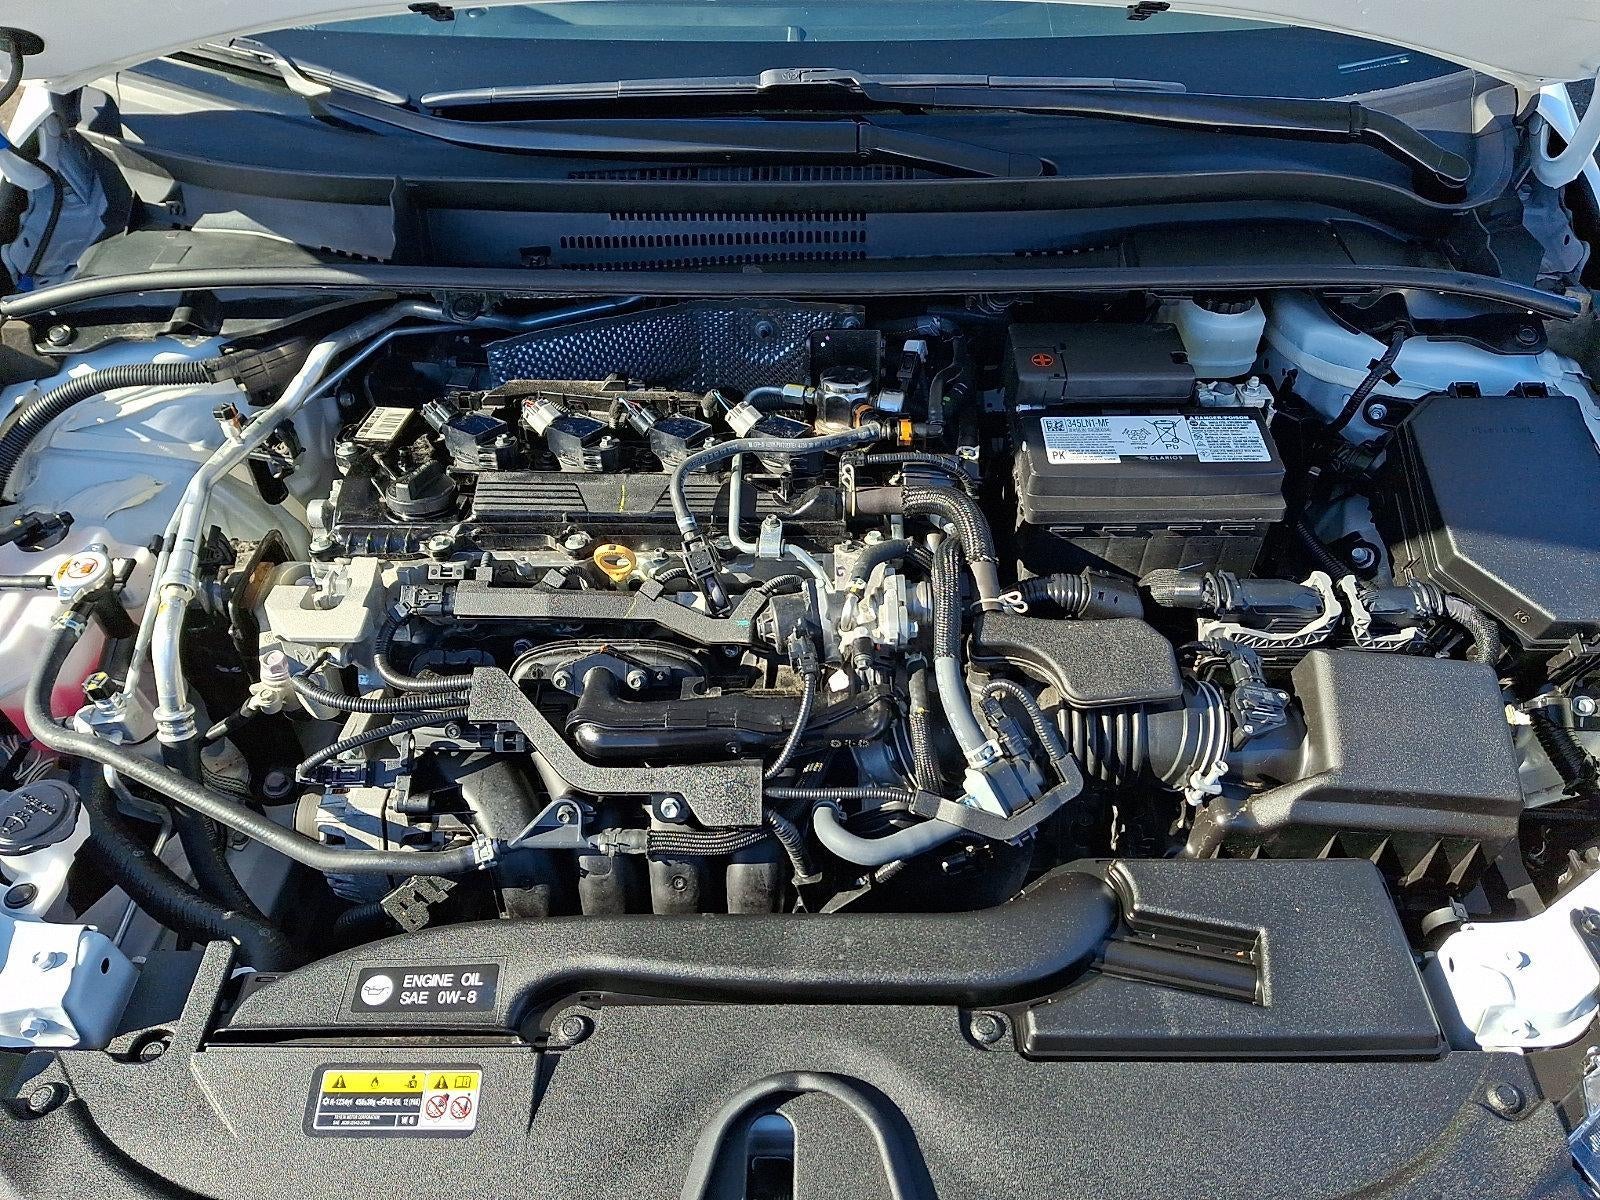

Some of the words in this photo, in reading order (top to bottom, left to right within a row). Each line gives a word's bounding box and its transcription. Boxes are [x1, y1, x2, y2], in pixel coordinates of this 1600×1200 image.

[1066, 418, 1110, 428] 345LN1-MF
[1052, 450, 1066, 460] PK
[1513, 610, 1531, 624] K6
[402, 973, 454, 988] ENGINE
[460, 972, 484, 986] OIL
[399, 991, 429, 1005] SAE
[437, 990, 478, 1005] 0W-8
